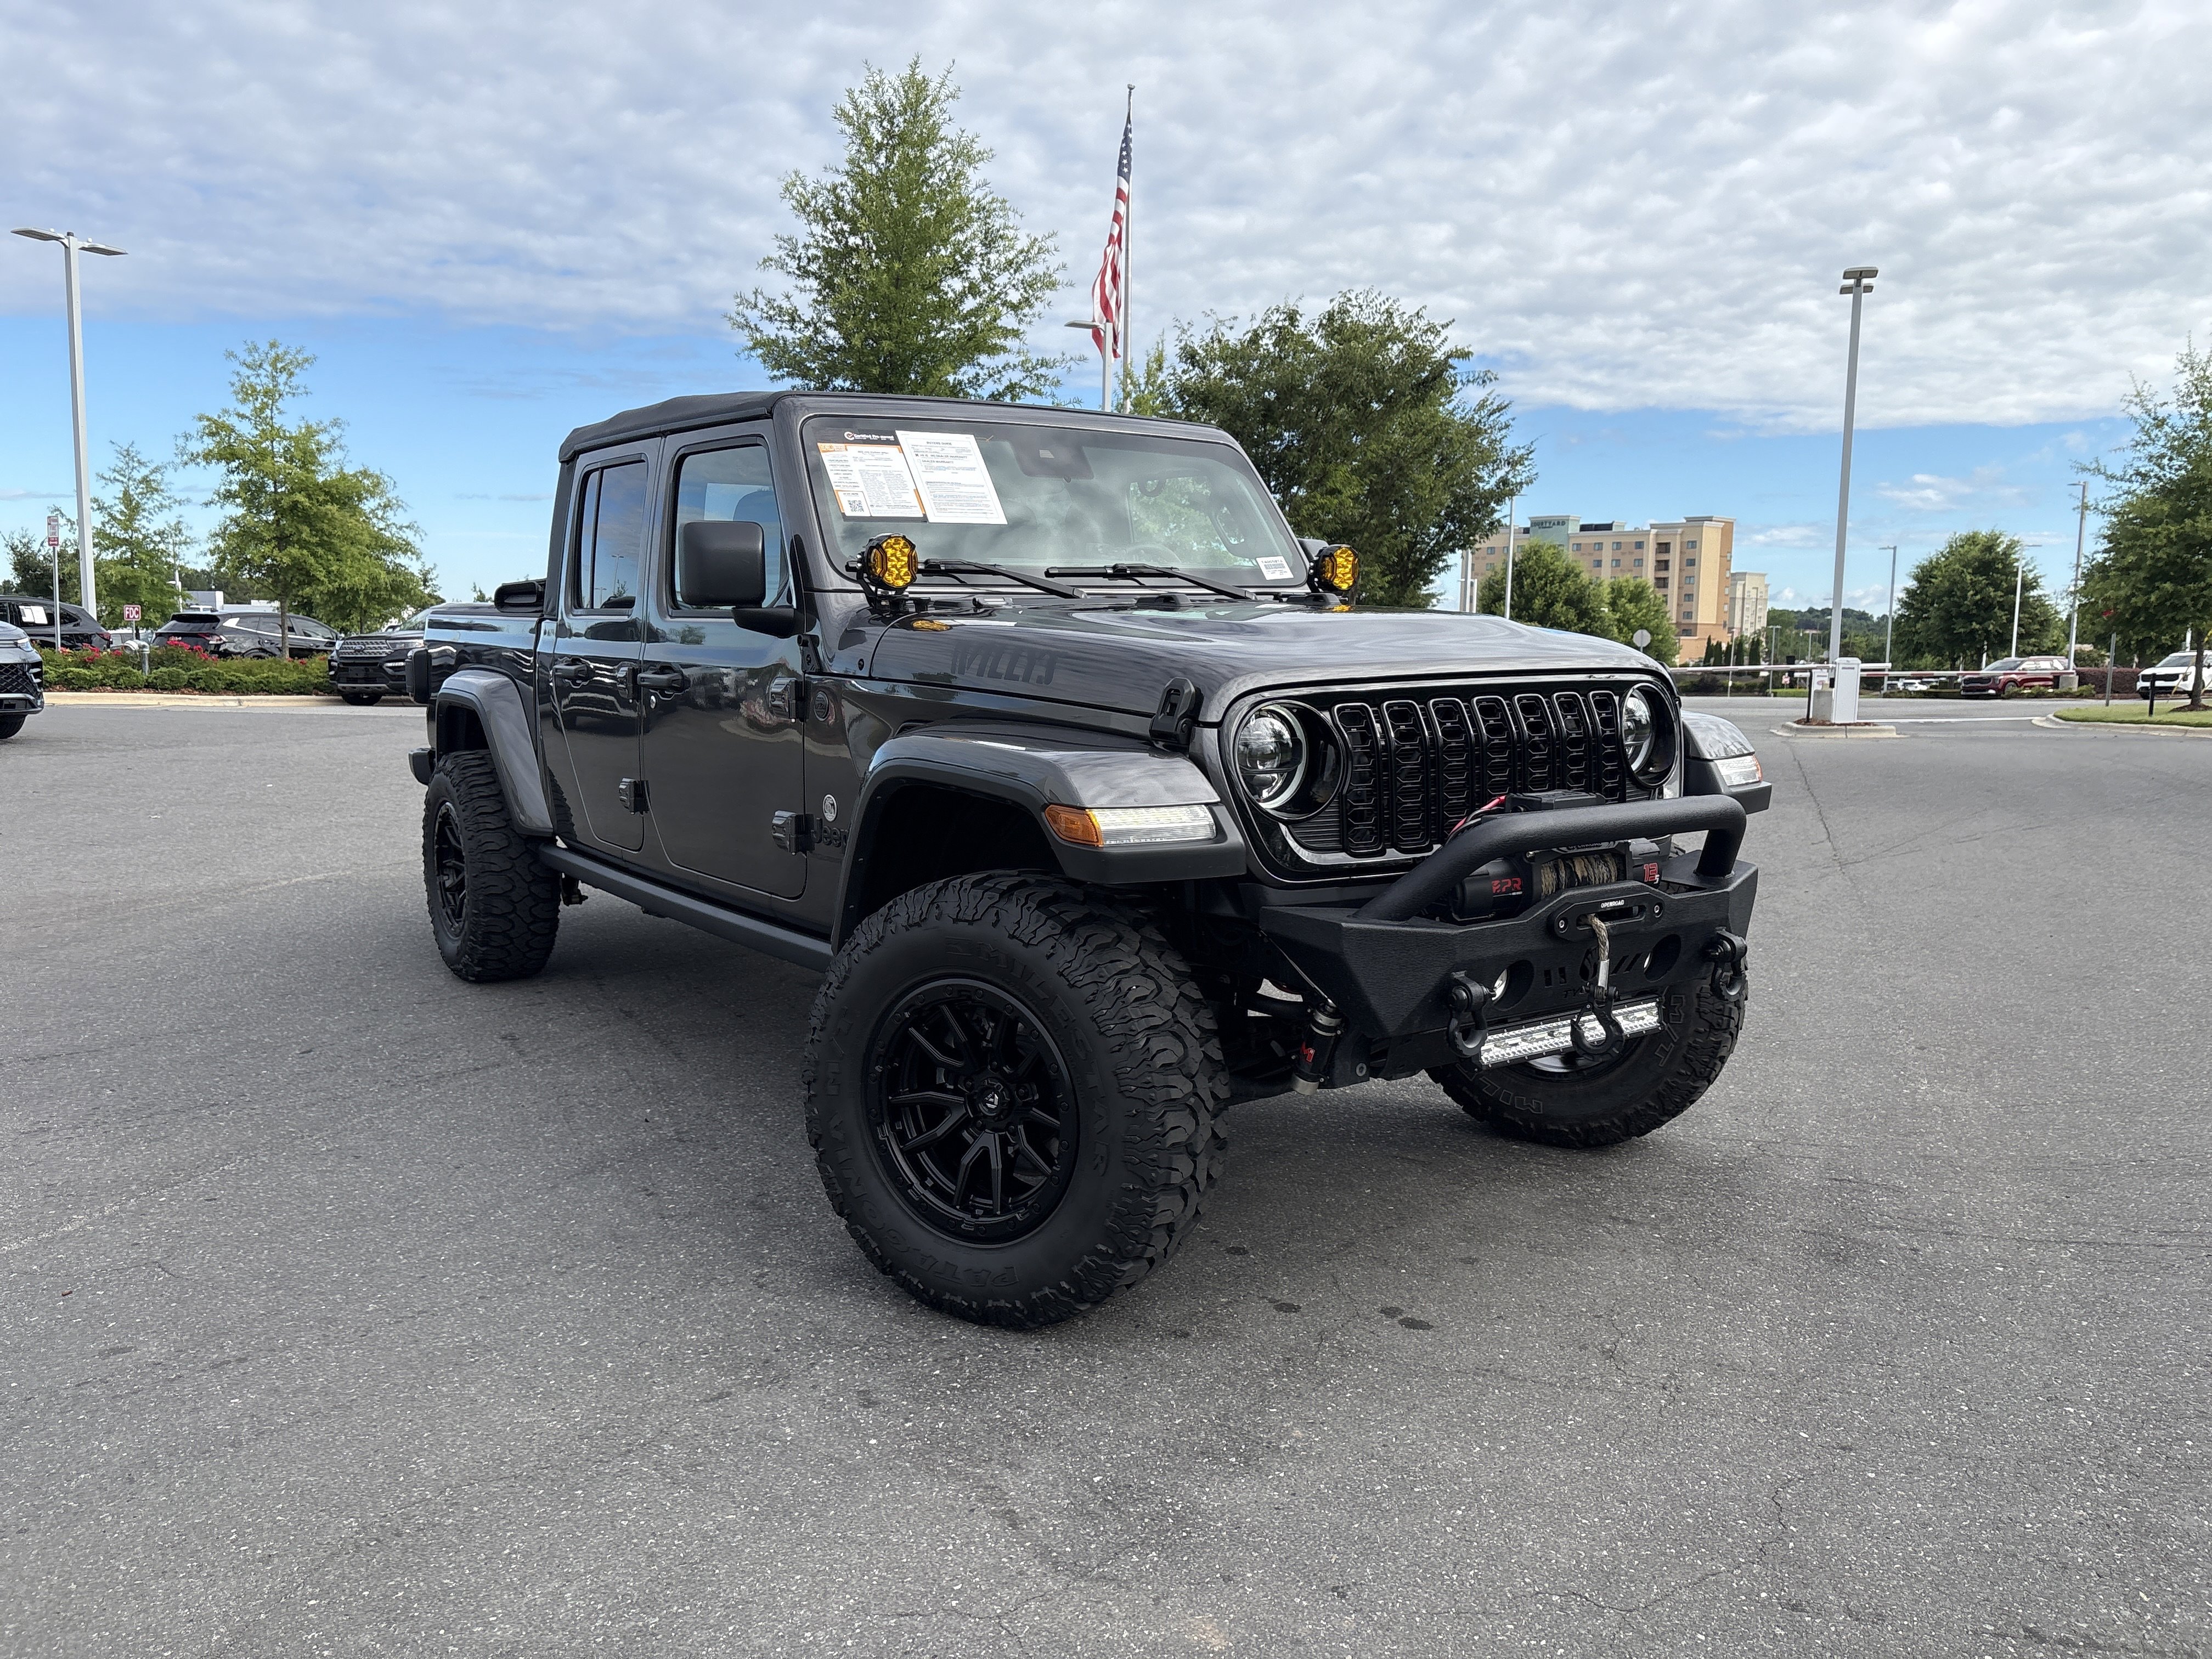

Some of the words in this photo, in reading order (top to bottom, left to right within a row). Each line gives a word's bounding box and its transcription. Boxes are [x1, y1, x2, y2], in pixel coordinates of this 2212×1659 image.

[125, 607, 139, 618] FDC
[950, 641, 1059, 685] WILLYS
[1600, 899, 1624, 909] OPENROAD
